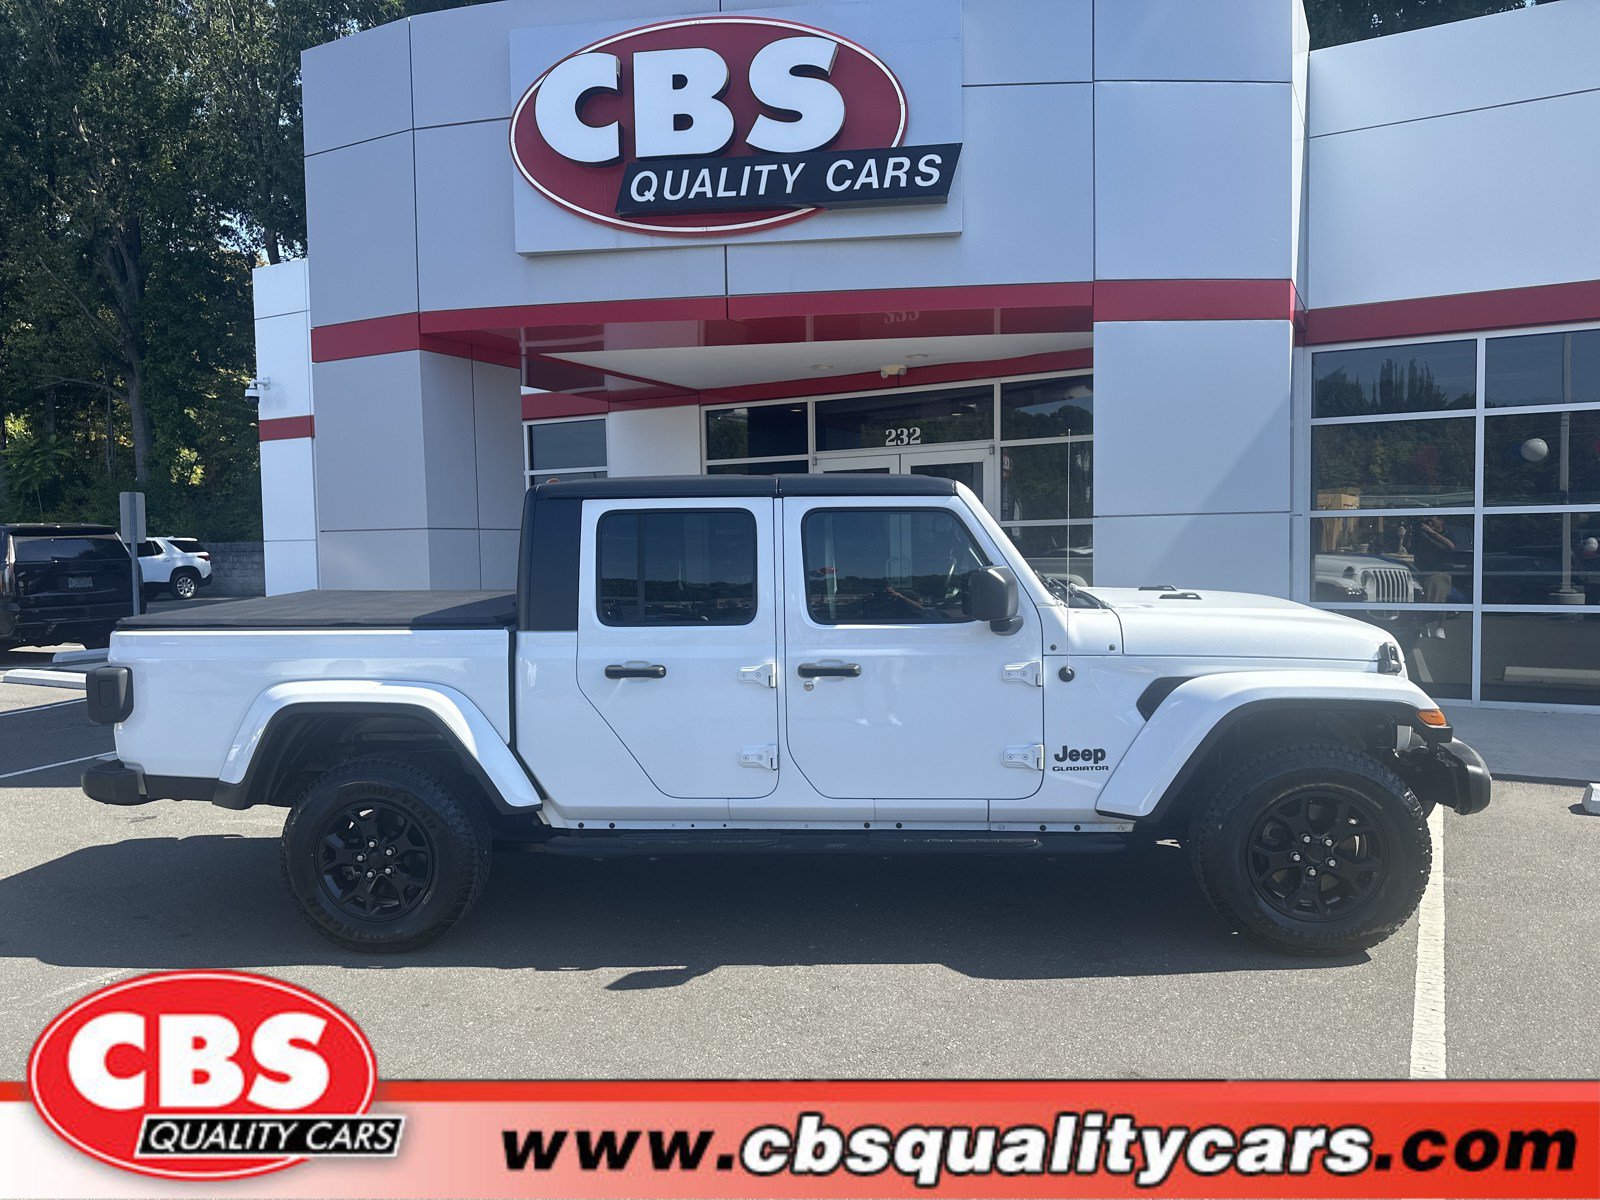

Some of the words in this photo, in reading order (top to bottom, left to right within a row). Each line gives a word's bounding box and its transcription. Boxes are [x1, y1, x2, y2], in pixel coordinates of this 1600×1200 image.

[535, 35, 848, 165] CBS
[630, 162, 806, 202] QUALITY
[825, 153, 943, 193] CARS
[885, 427, 921, 446] 232
[1054, 745, 1106, 765] Jeep
